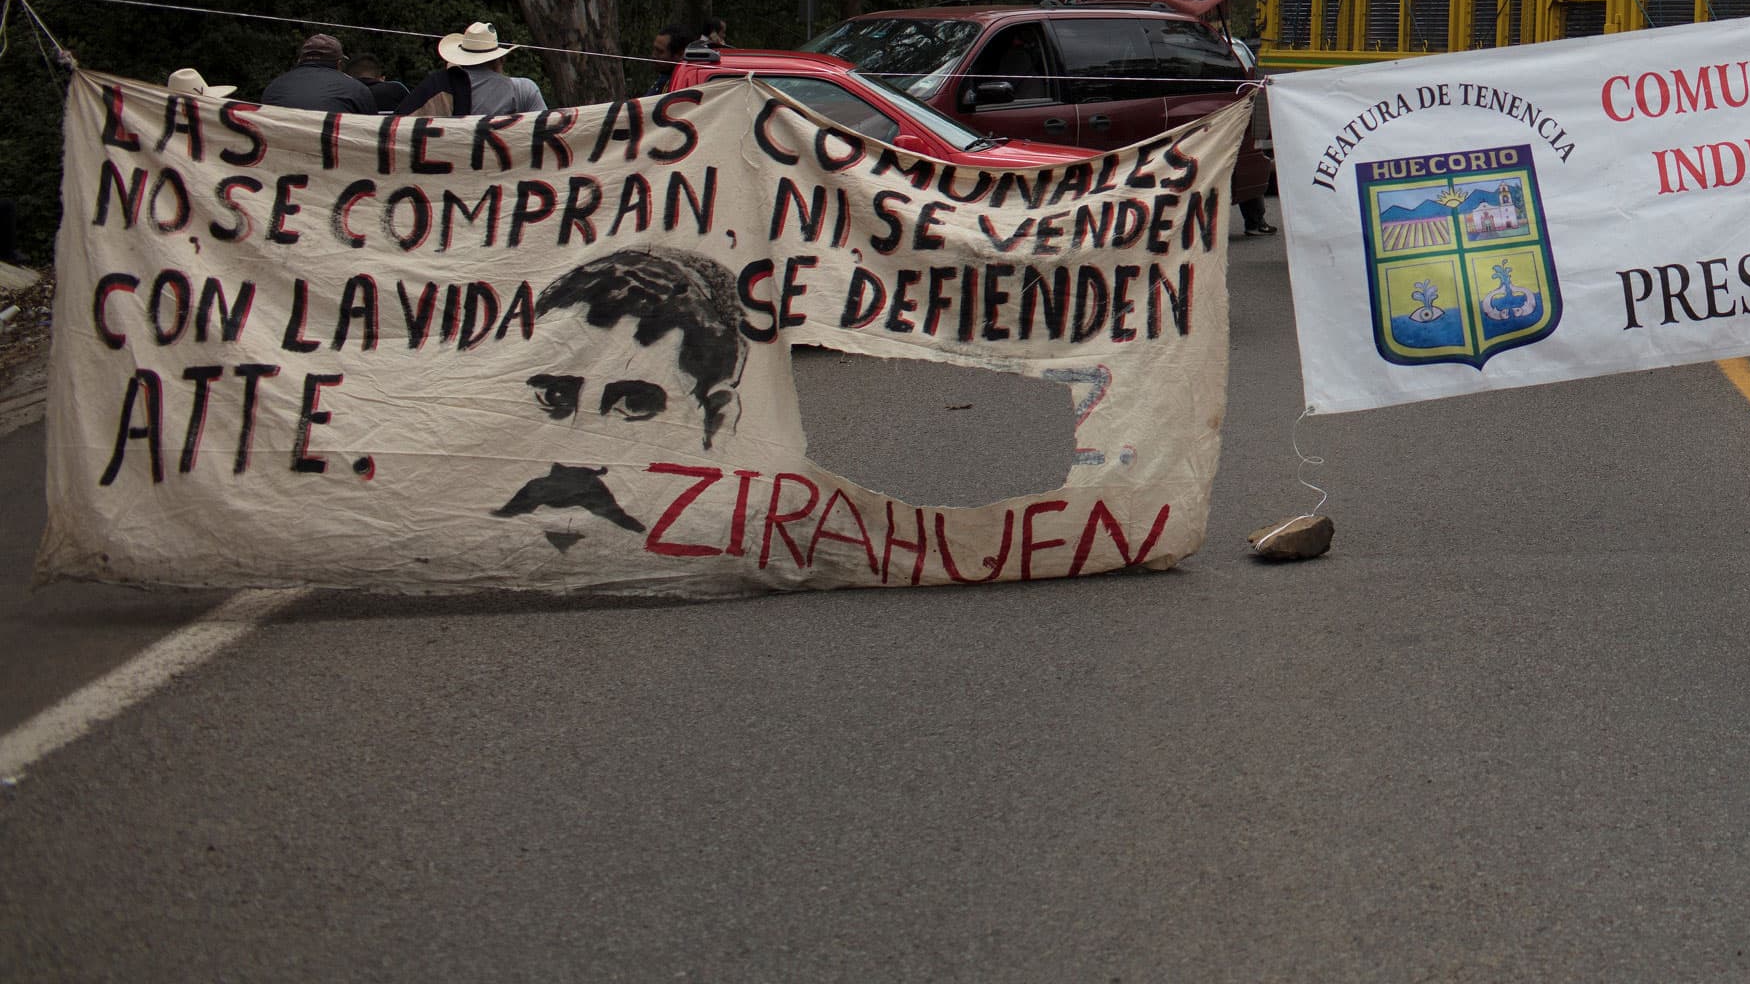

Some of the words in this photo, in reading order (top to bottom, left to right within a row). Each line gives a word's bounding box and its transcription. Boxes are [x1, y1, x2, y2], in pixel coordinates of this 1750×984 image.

[102, 84, 269, 167] LAS
[754, 98, 1212, 210] COMUNALES
[1312, 93, 1414, 192] JEFATURA
[1416, 84, 1451, 110] DE
[1458, 83, 1576, 164] TENENCIA
[1372, 148, 1519, 180] HUECORIO
[209, 173, 309, 244] SE
[329, 167, 737, 253] COMPRAN,
[869, 190, 957, 256] SE
[978, 187, 1220, 257] VENDEN
[94, 269, 256, 350] CON
[281, 273, 379, 354] LA
[396, 279, 536, 352] VIDA
[737, 255, 820, 345] SE
[839, 262, 1196, 344] DEFIENDEN
[99, 363, 375, 486] ATTE.
